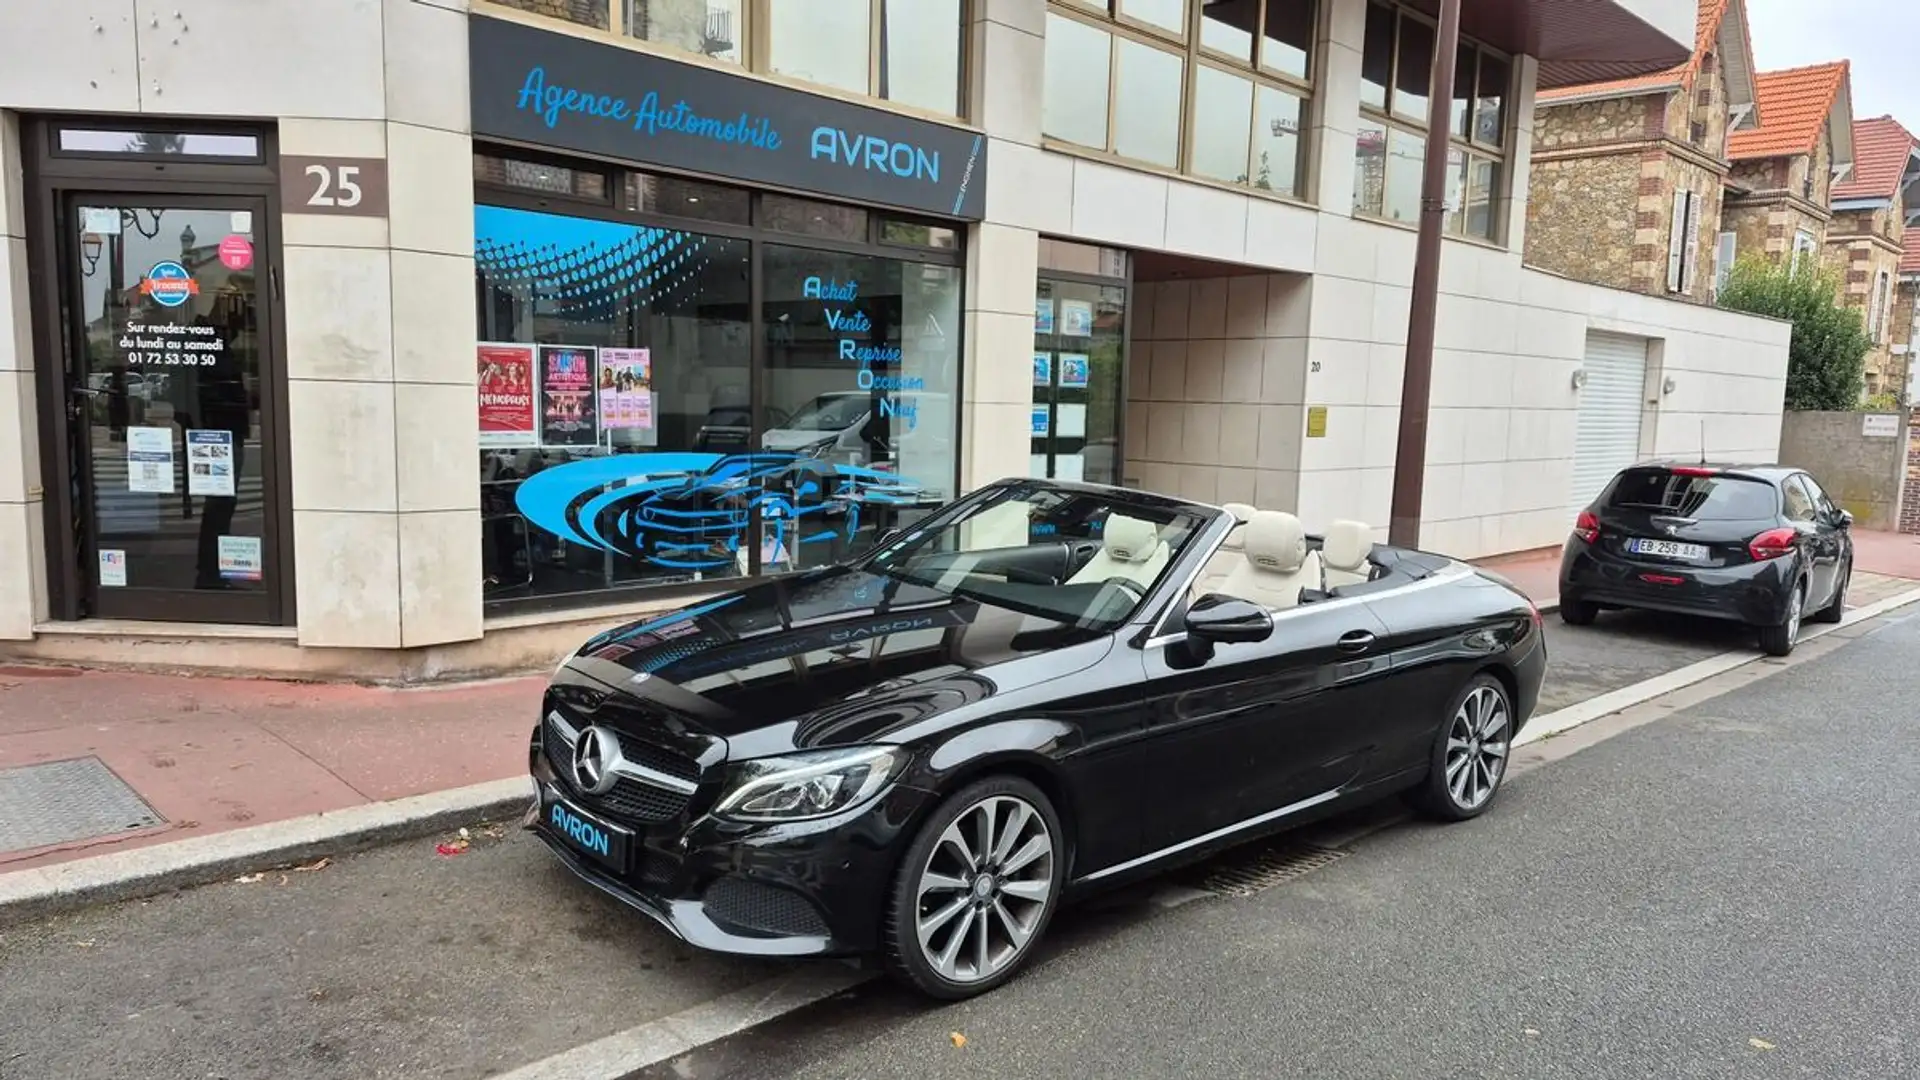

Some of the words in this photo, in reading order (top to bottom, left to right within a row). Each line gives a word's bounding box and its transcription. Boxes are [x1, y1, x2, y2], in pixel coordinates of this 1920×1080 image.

[517, 66, 630, 129] Agence
[633, 91, 782, 150] Automobile
[811, 126, 940, 184] AVRON
[305, 165, 362, 208] 25
[804, 276, 858, 303] Achat
[127, 321, 146, 333] Sur
[148, 321, 215, 336] rendez-vous
[824, 308, 872, 331] Vente
[119, 335, 134, 348] du
[136, 335, 164, 349] lundi
[166, 340, 181, 349] au
[184, 337, 223, 351] samedi
[839, 339, 904, 370] Reprise
[128, 351, 142, 364] 01
[146, 352, 162, 365] 72
[164, 353, 180, 365] 53
[182, 353, 198, 366] 30
[200, 354, 216, 367] 50
[551, 803, 609, 857] AVRON
